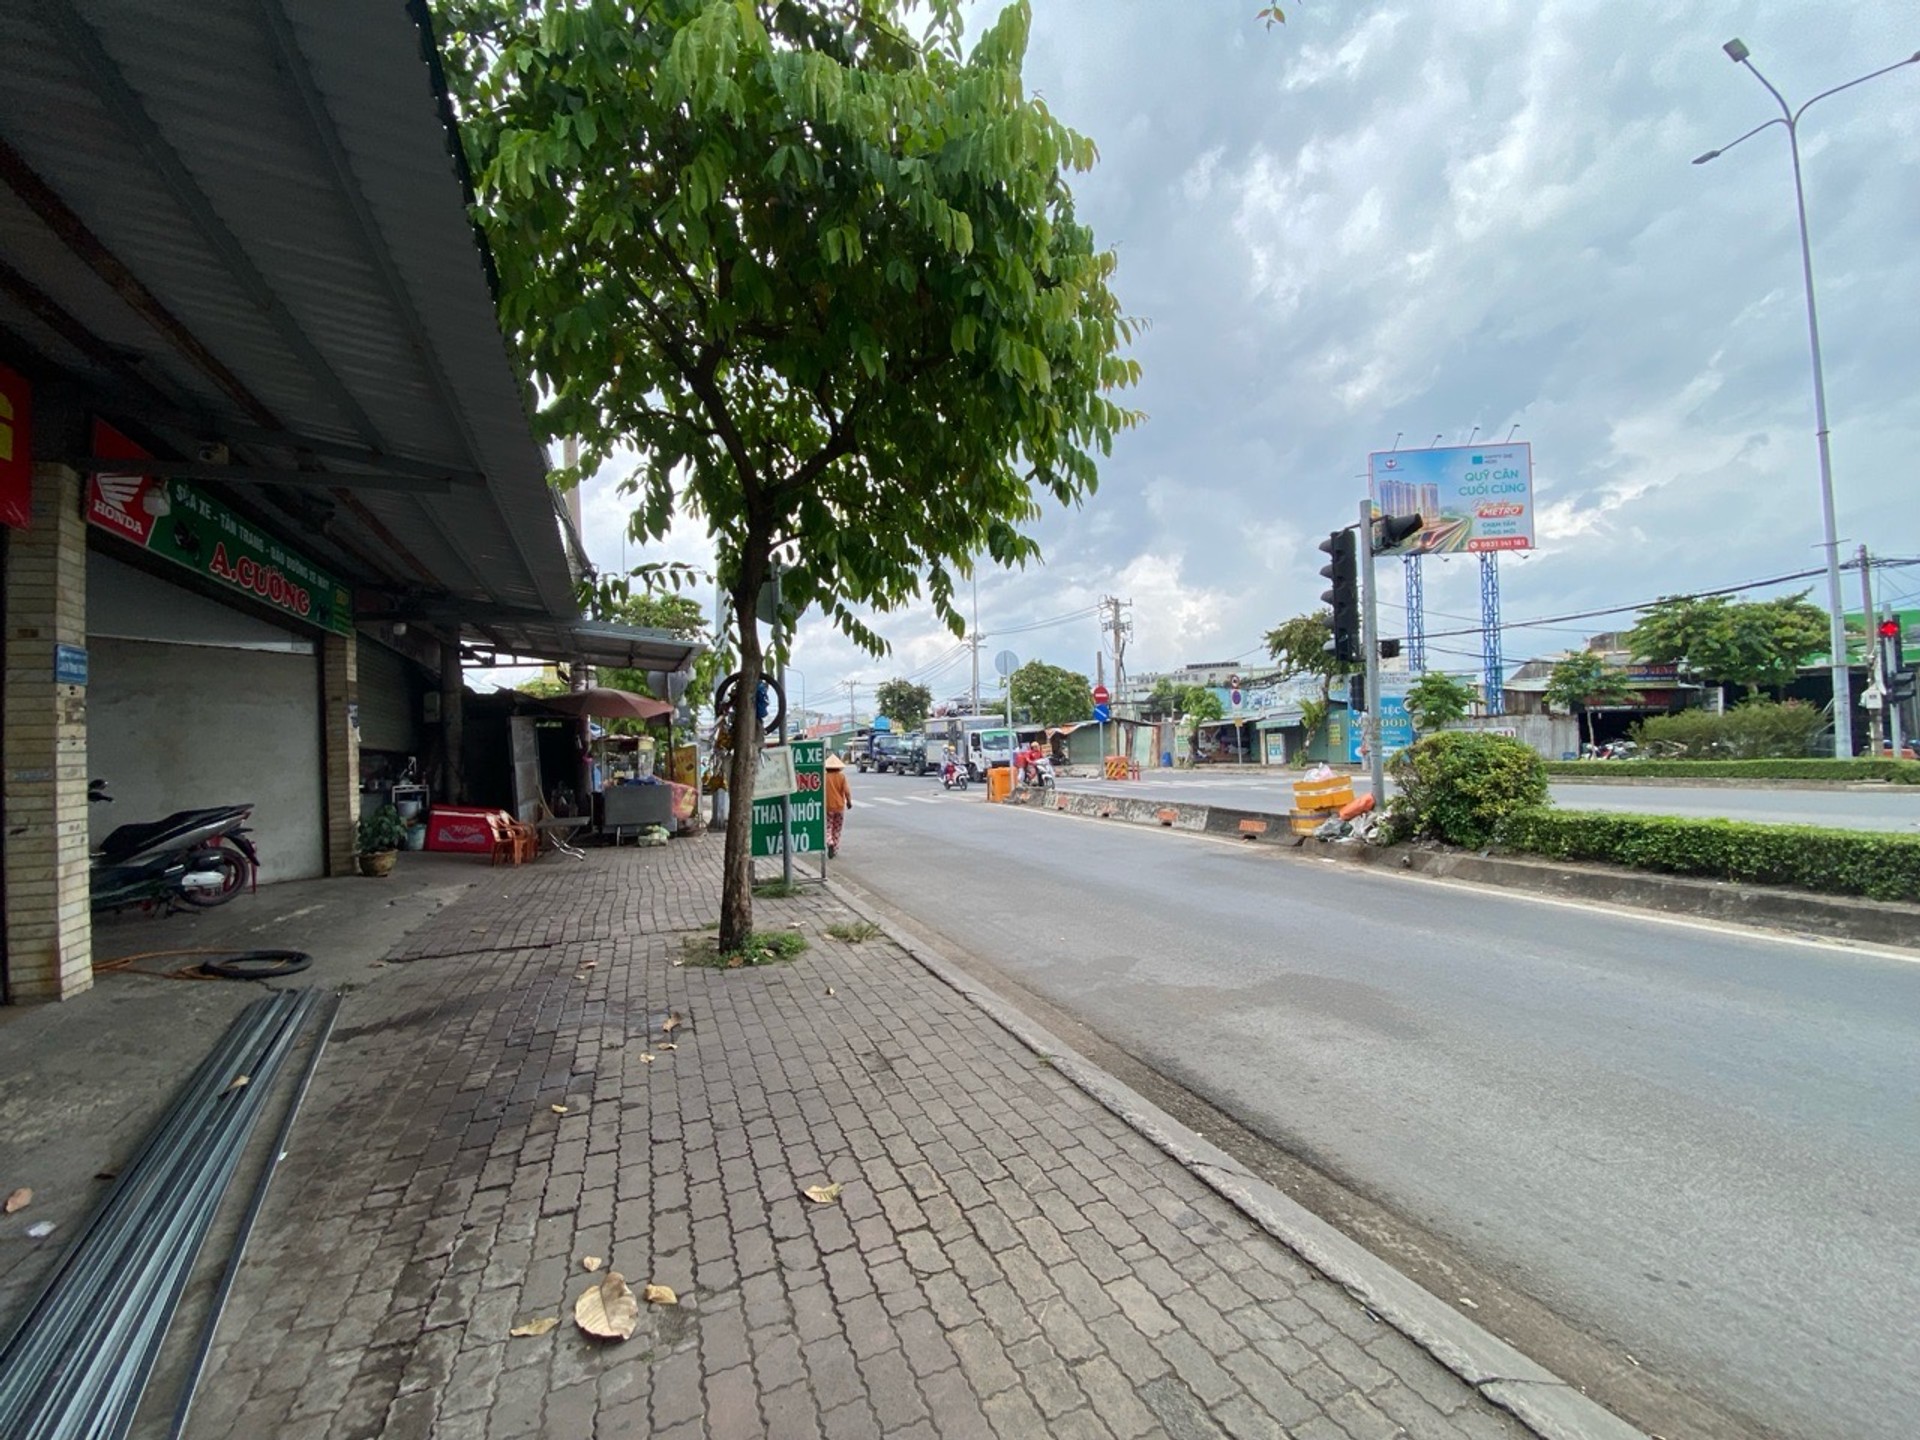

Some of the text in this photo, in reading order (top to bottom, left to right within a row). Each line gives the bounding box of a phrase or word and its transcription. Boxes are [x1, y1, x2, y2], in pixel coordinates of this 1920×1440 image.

[1464, 469, 1490, 482] QUỸ
[1458, 482, 1526, 496] CUỐI CÙNG
[93, 499, 144, 536] HONDA
[199, 499, 213, 521] XE
[1482, 506, 1519, 516] METRO
[209, 541, 312, 617] A.CƯỜNG
[807, 747, 823, 763] XE
[790, 827, 810, 852] VỎ
